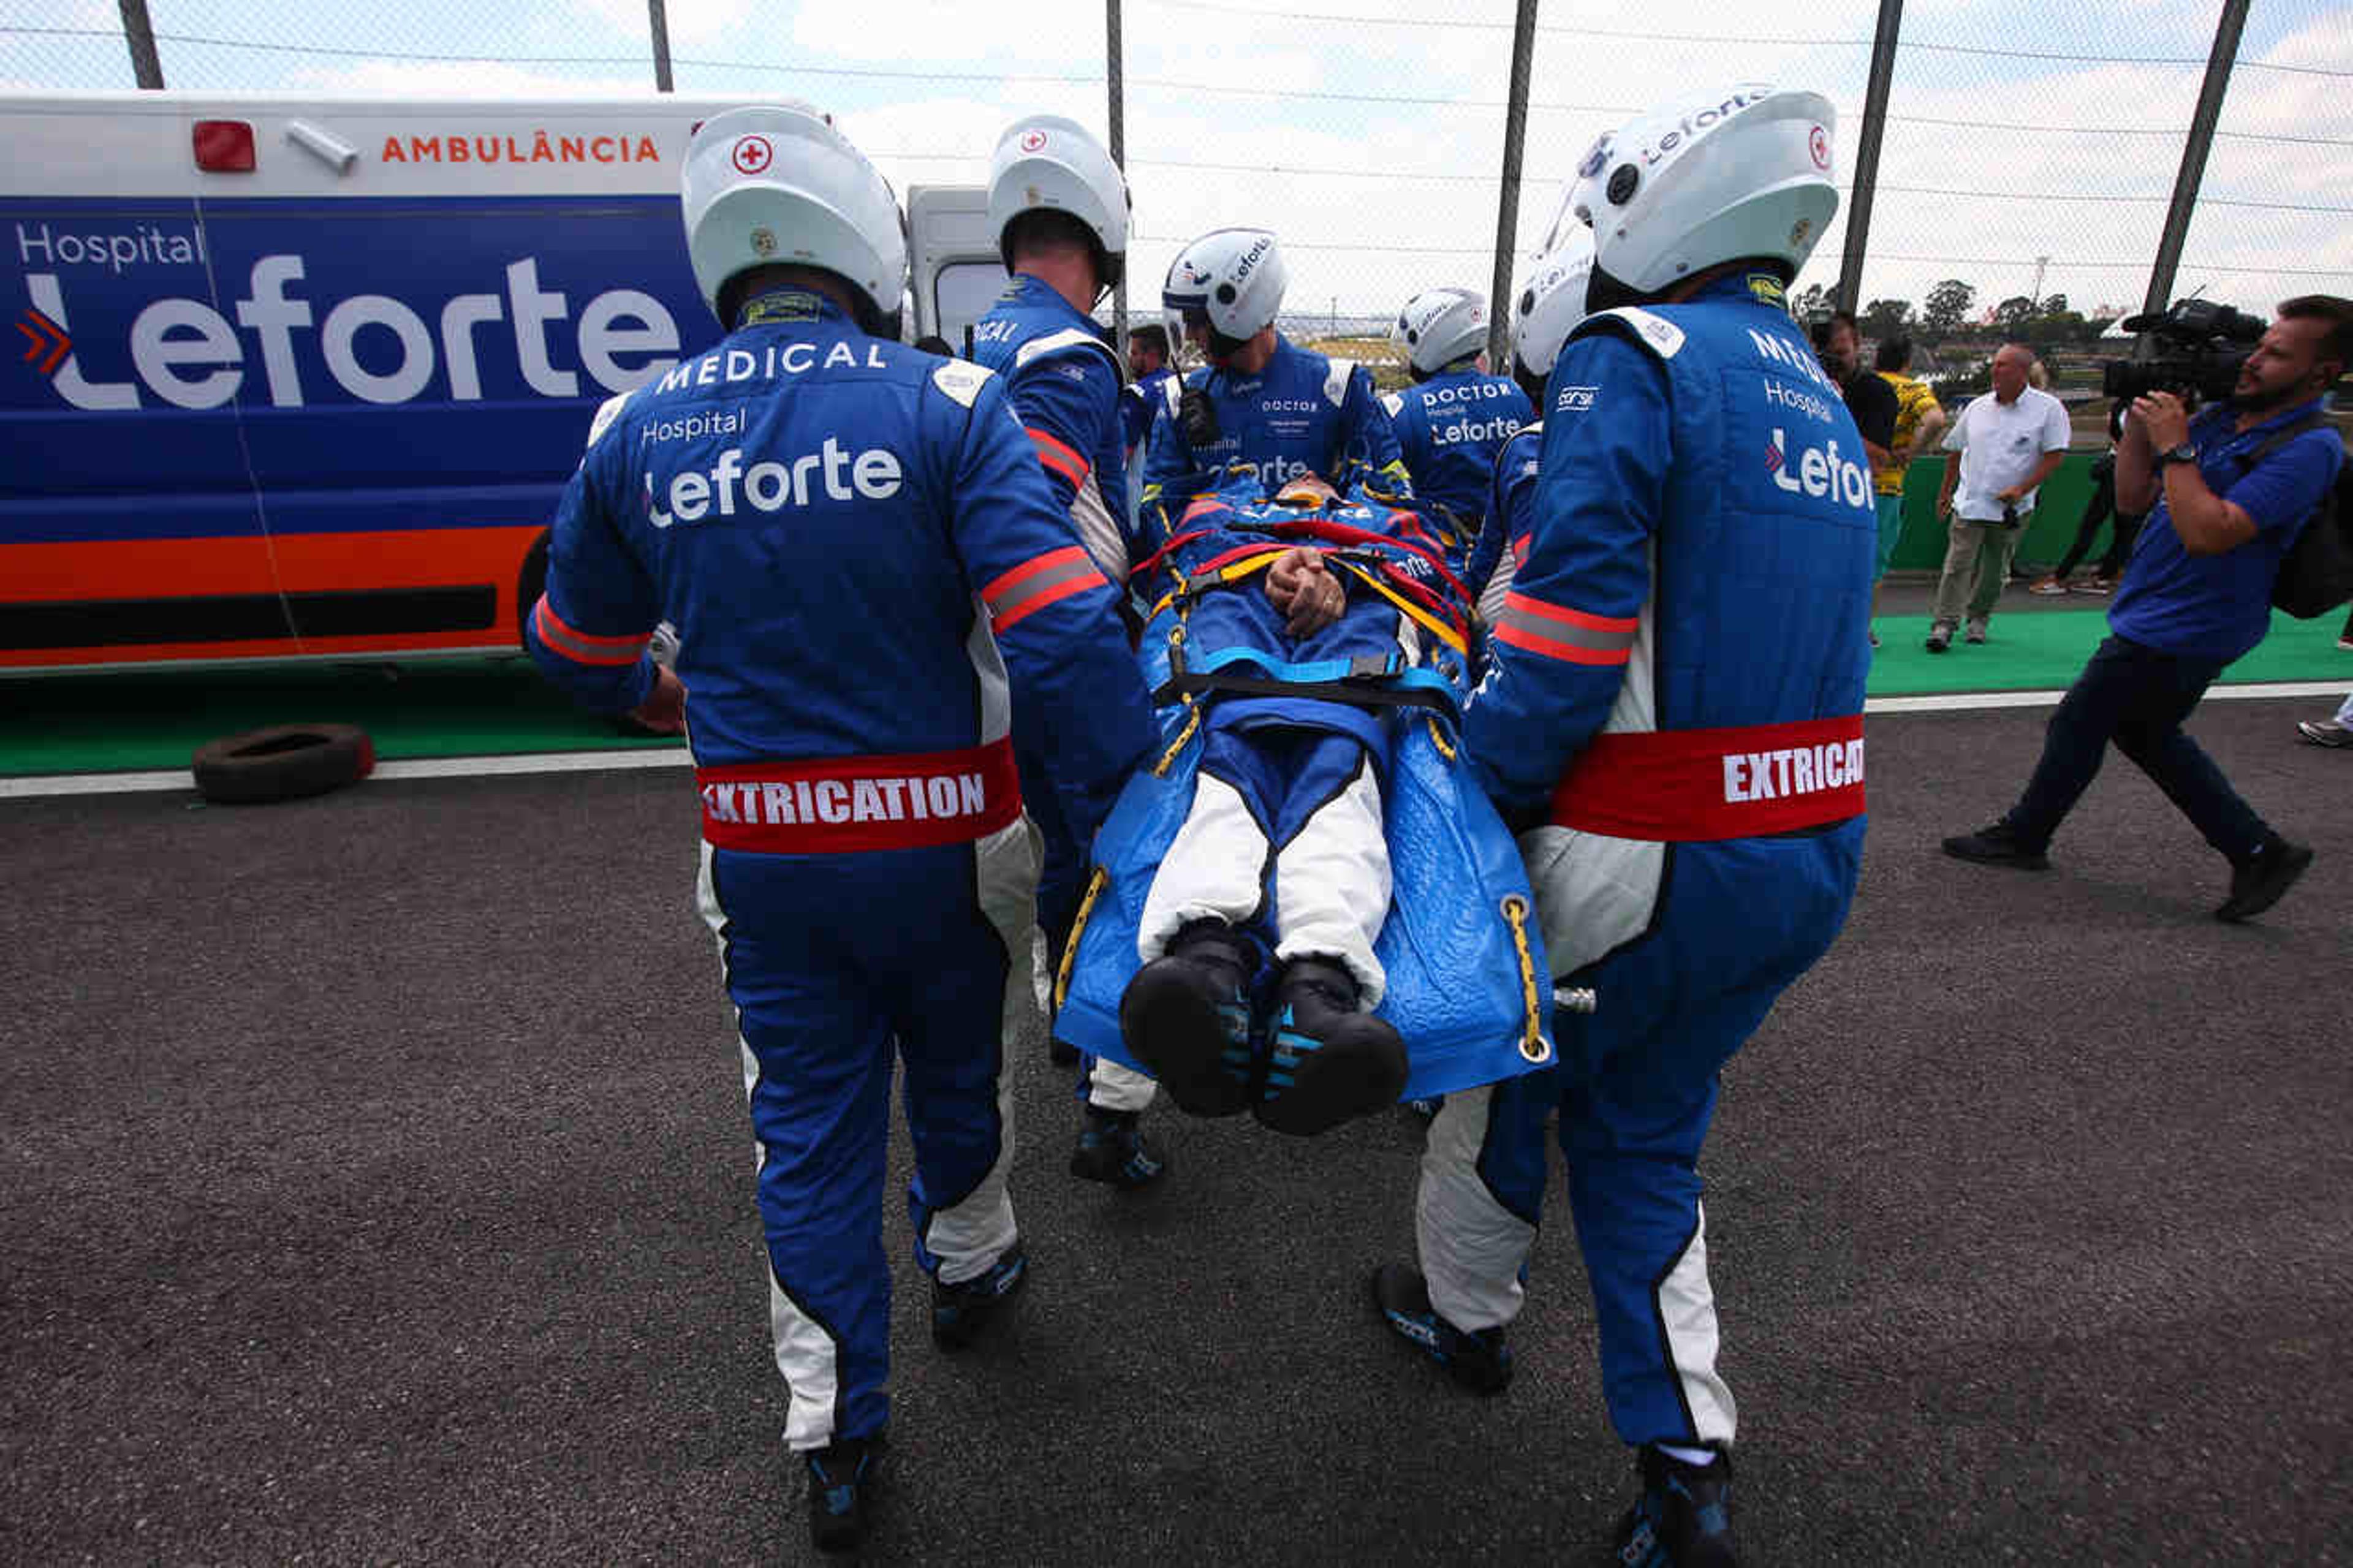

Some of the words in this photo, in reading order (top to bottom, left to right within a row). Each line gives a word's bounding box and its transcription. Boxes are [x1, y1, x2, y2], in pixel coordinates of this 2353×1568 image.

[382, 130, 660, 162] AMBULÂNCIA
[16, 222, 206, 273] Hospital
[26, 254, 680, 410] Leforte
[656, 341, 889, 396] MEDICAL
[1262, 400, 1317, 412] DOCTOR
[1422, 382, 1512, 407] DOCTOR
[642, 407, 746, 445] Hospital
[1431, 417, 1520, 445] Leforte
[645, 436, 901, 528] Leforte
